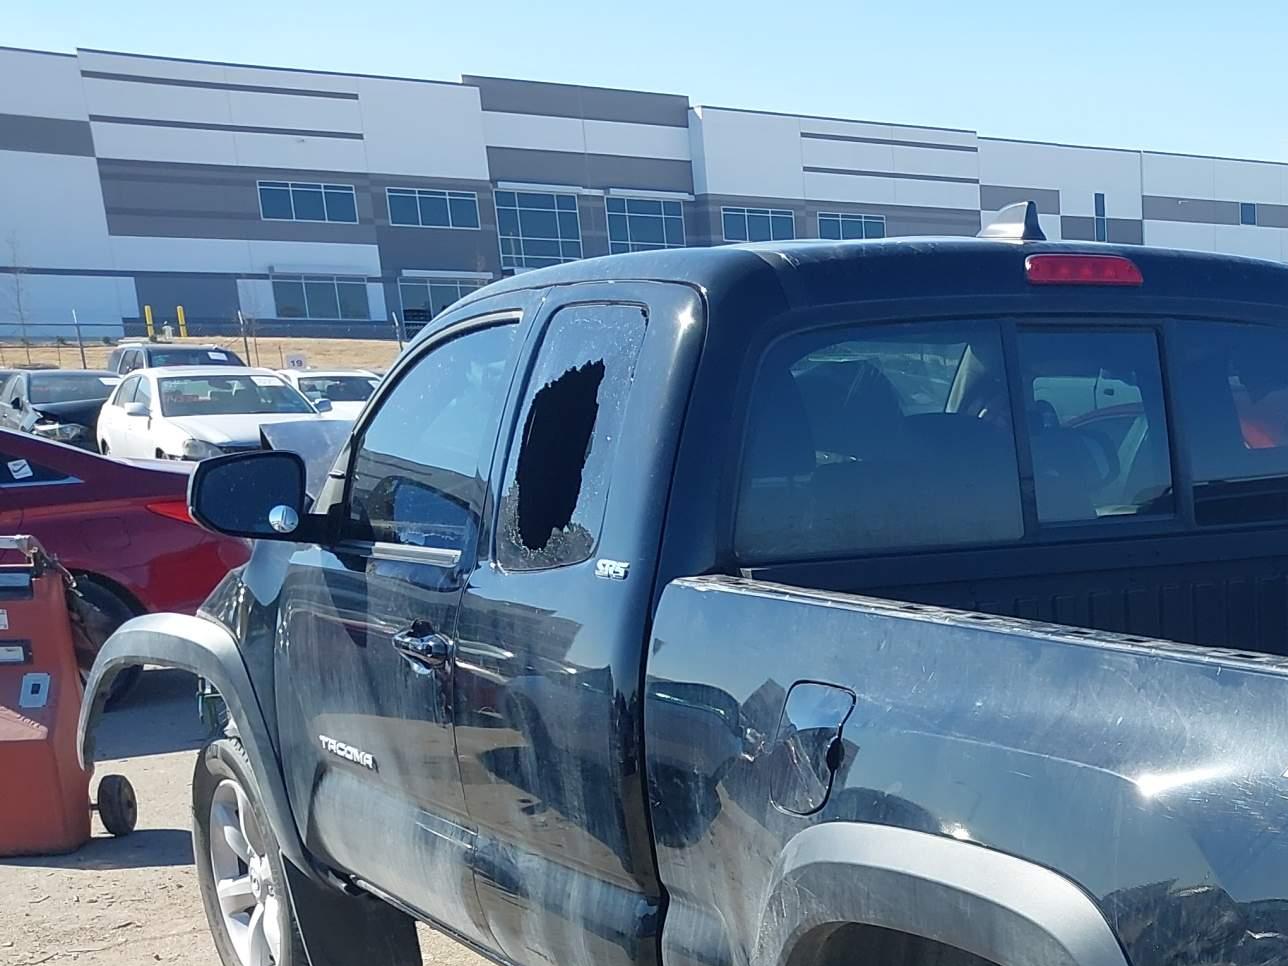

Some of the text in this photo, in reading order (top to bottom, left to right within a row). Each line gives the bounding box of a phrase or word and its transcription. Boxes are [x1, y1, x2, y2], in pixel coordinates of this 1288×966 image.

[290, 359, 304, 368] 19
[595, 559, 630, 580] SR5
[319, 734, 374, 769] TACOMA
